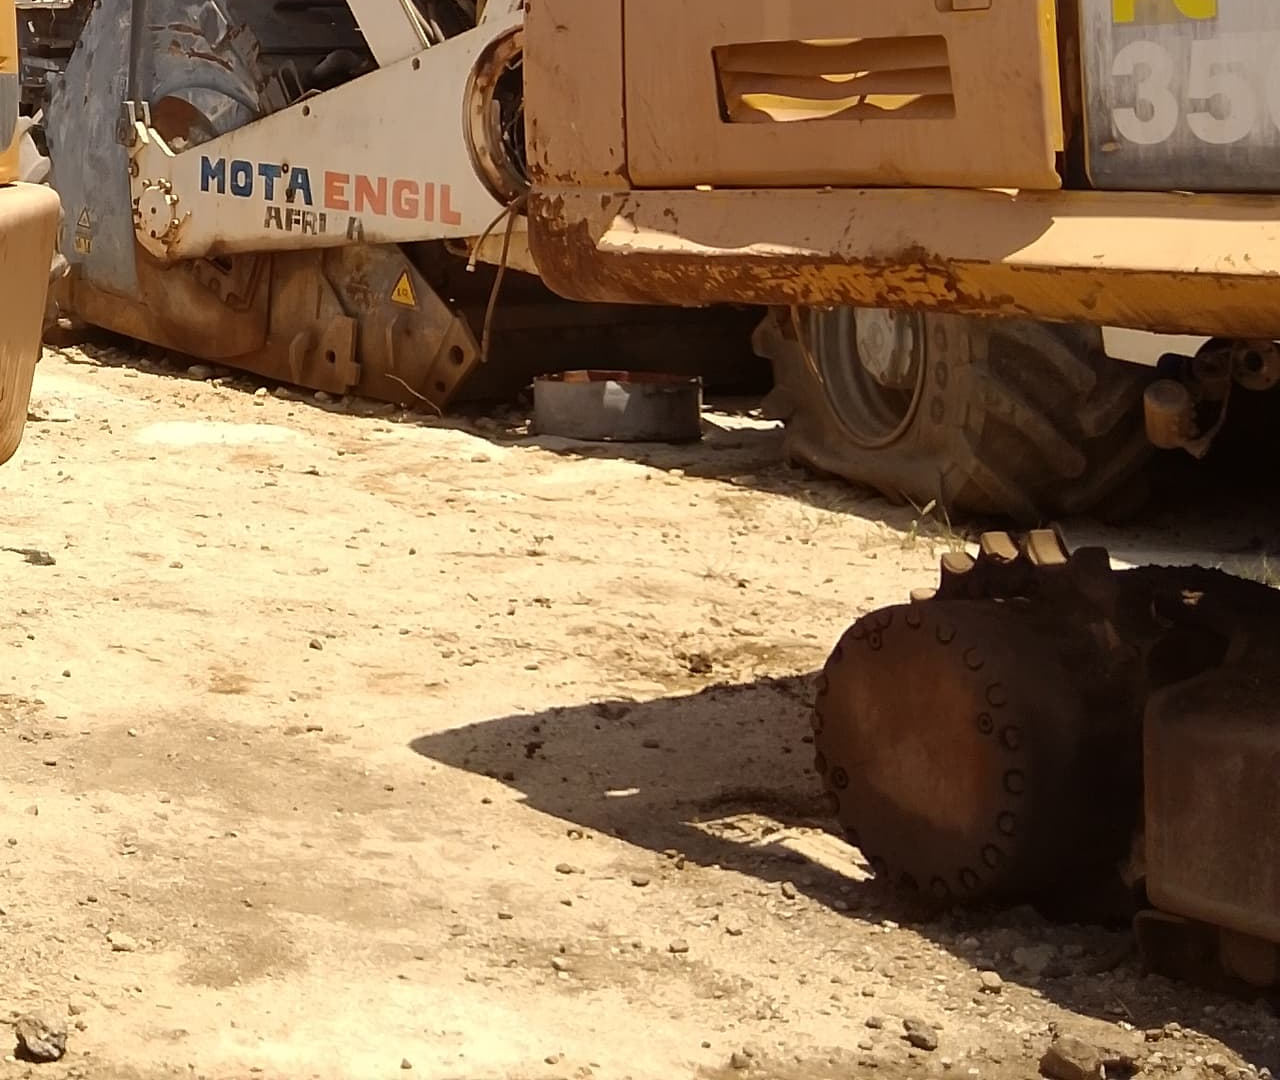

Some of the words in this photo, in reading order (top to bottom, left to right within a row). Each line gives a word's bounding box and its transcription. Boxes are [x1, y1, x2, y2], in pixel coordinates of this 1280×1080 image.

[1111, 39, 1280, 145] 35
[200, 156, 313, 206] MOTA
[323, 170, 461, 226] ENGIL
